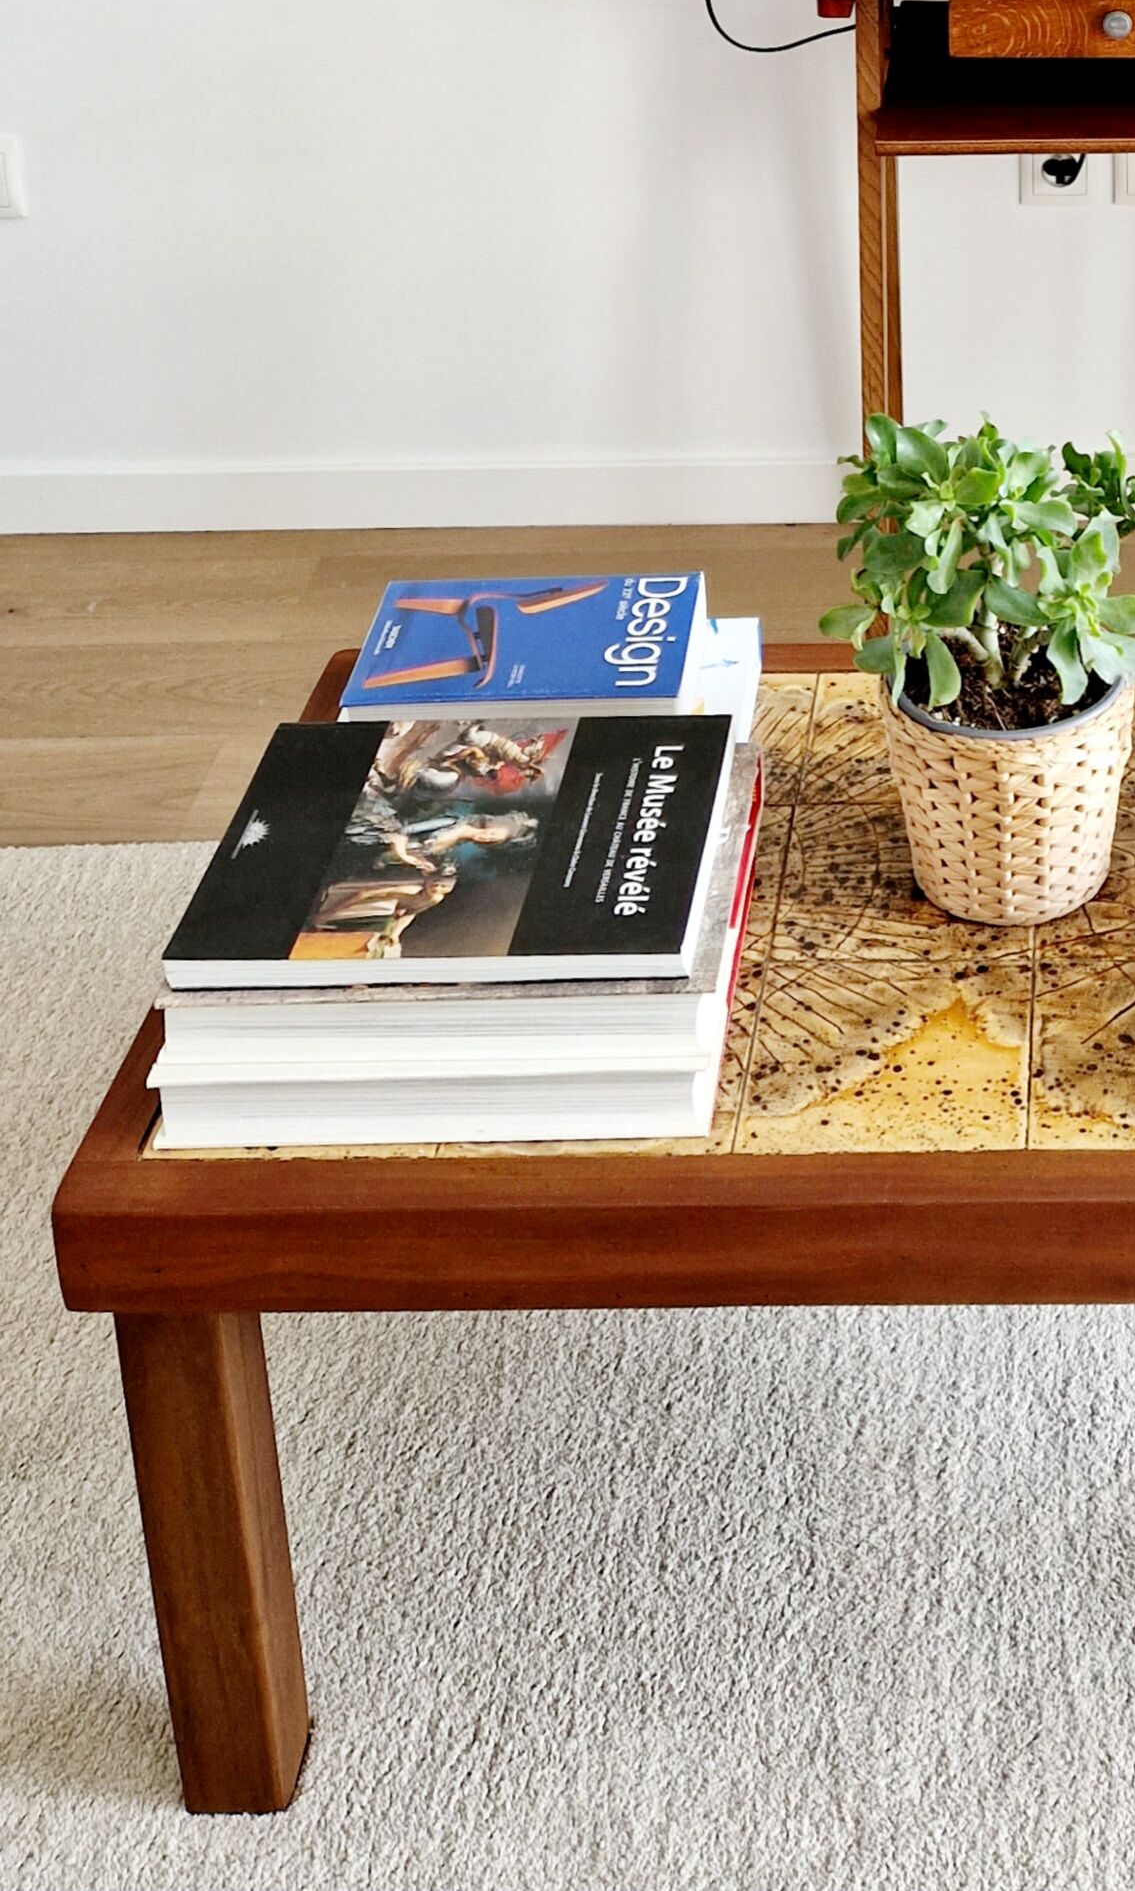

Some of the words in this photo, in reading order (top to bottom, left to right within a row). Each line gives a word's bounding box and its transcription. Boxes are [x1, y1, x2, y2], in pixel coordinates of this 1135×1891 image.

[603, 577, 688, 686] Design
[651, 745, 685, 769] Le
[633, 774, 678, 842] Musée
[614, 847, 657, 916] révélé
